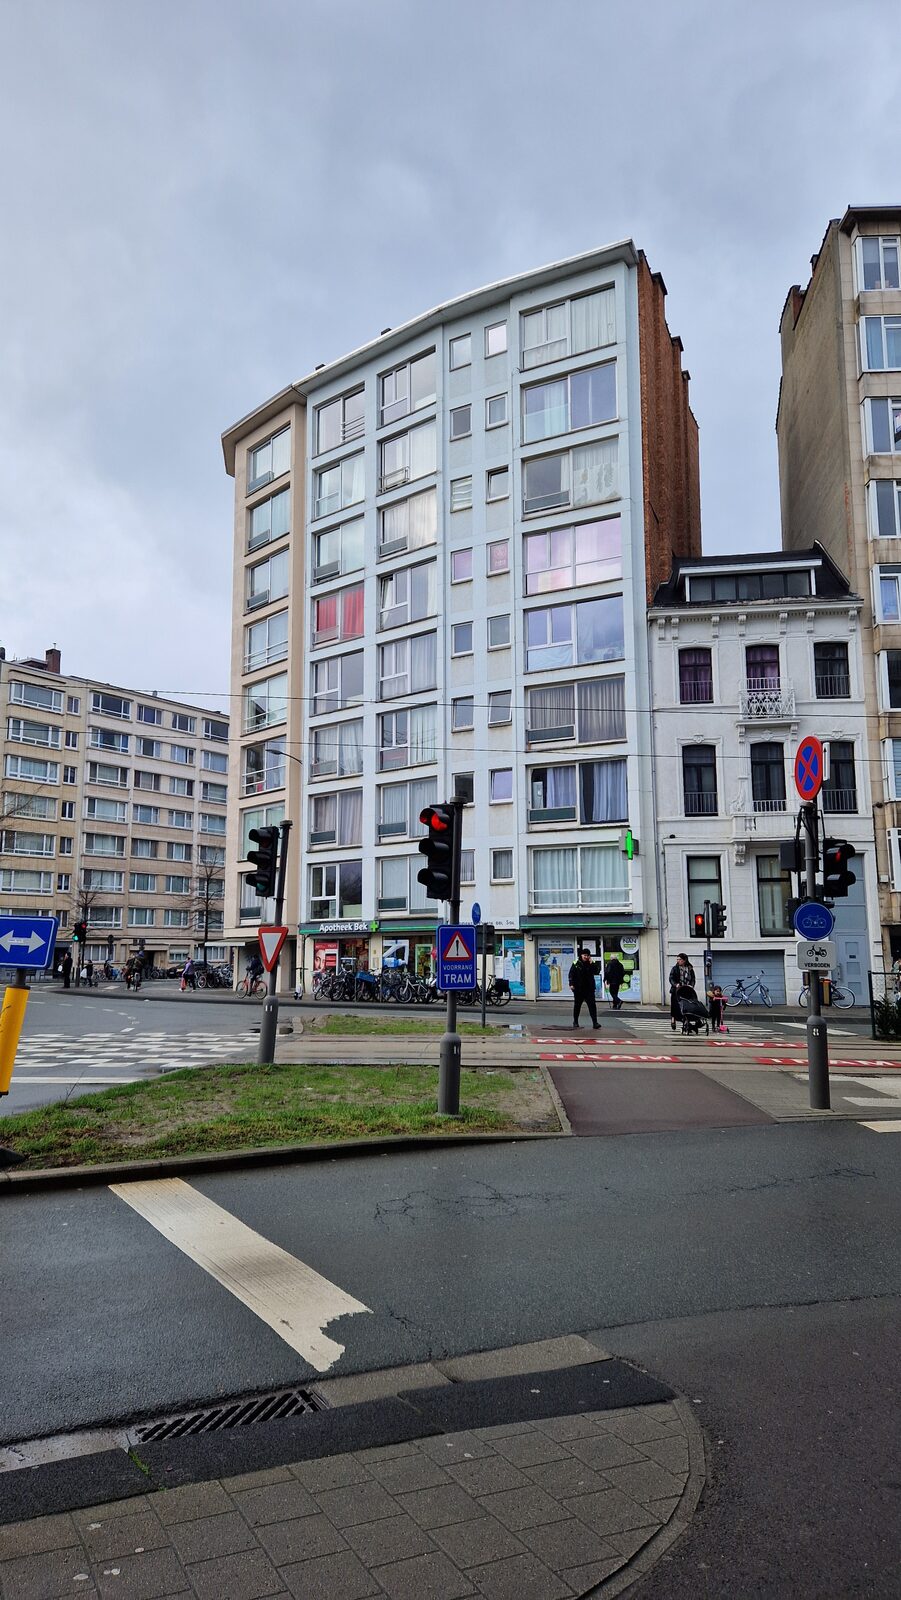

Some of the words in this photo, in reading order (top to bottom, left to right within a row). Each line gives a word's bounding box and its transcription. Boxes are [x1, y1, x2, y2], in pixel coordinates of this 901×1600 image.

[319, 923, 353, 933] Apotheek
[354, 922, 368, 931] Bek
[444, 973, 472, 984] TRAM
